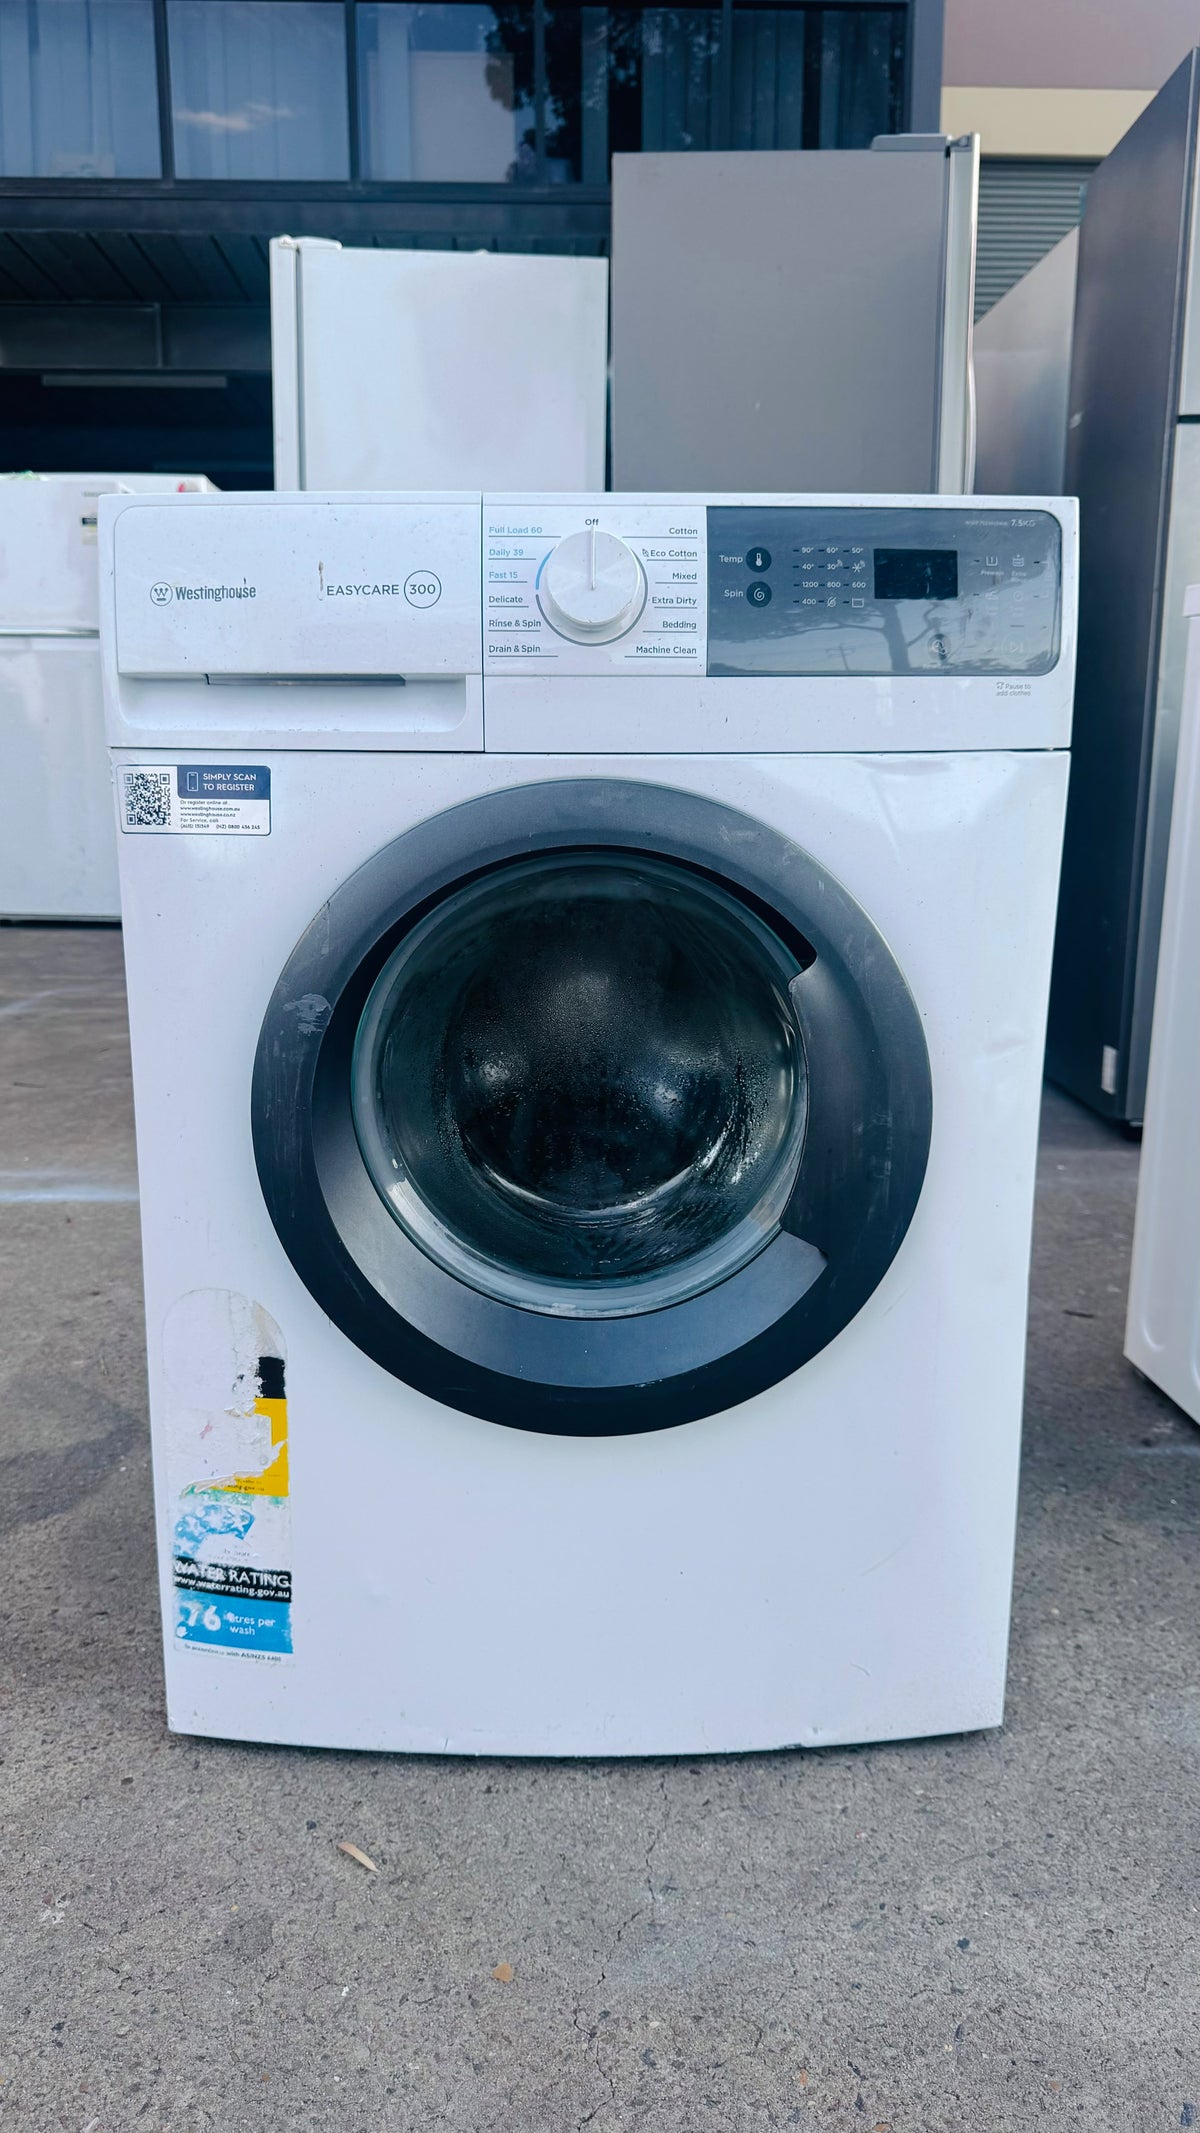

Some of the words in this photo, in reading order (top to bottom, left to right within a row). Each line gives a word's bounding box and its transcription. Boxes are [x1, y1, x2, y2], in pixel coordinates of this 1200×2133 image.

[584, 518, 599, 526] Off
[489, 526, 505, 535] Full
[507, 526, 528, 535] Load
[530, 526, 542, 534] 60
[668, 527, 698, 535] Cotton
[489, 548, 510, 558] Daily
[512, 548, 524, 556] 39
[650, 550, 666, 558] Eco
[668, 550, 698, 558] Cotton
[719, 554, 744, 564] Temp
[489, 571, 507, 579] Fast
[508, 571, 518, 579] 15
[672, 572, 698, 580] Mixed
[174, 584, 256, 602] Westinghouse
[326, 584, 400, 596] EASYCARE
[409, 584, 436, 595] 300
[724, 589, 744, 598] Spin
[488, 595, 524, 604] Delicate
[652, 596, 674, 604] Extra
[676, 596, 697, 606] Dirty
[488, 620, 512, 628] Rinse
[514, 620, 521, 628] &
[522, 620, 542, 630] Spin
[662, 621, 697, 630] Bedding
[488, 645, 512, 653] Drain
[514, 645, 520, 653] &
[520, 645, 541, 654] Spin
[636, 646, 671, 654] Machine
[673, 646, 697, 654] Clean
[203, 773, 231, 781] SIMPLY
[234, 773, 257, 781] SCAN
[203, 783, 214, 791] TO
[174, 1560, 226, 1580] WATER
[228, 1569, 290, 1588] RATING
[174, 1576, 290, 1598] www.waterrating.gov.au
[258, 1618, 276, 1628] per
[230, 1626, 256, 1636] wash
